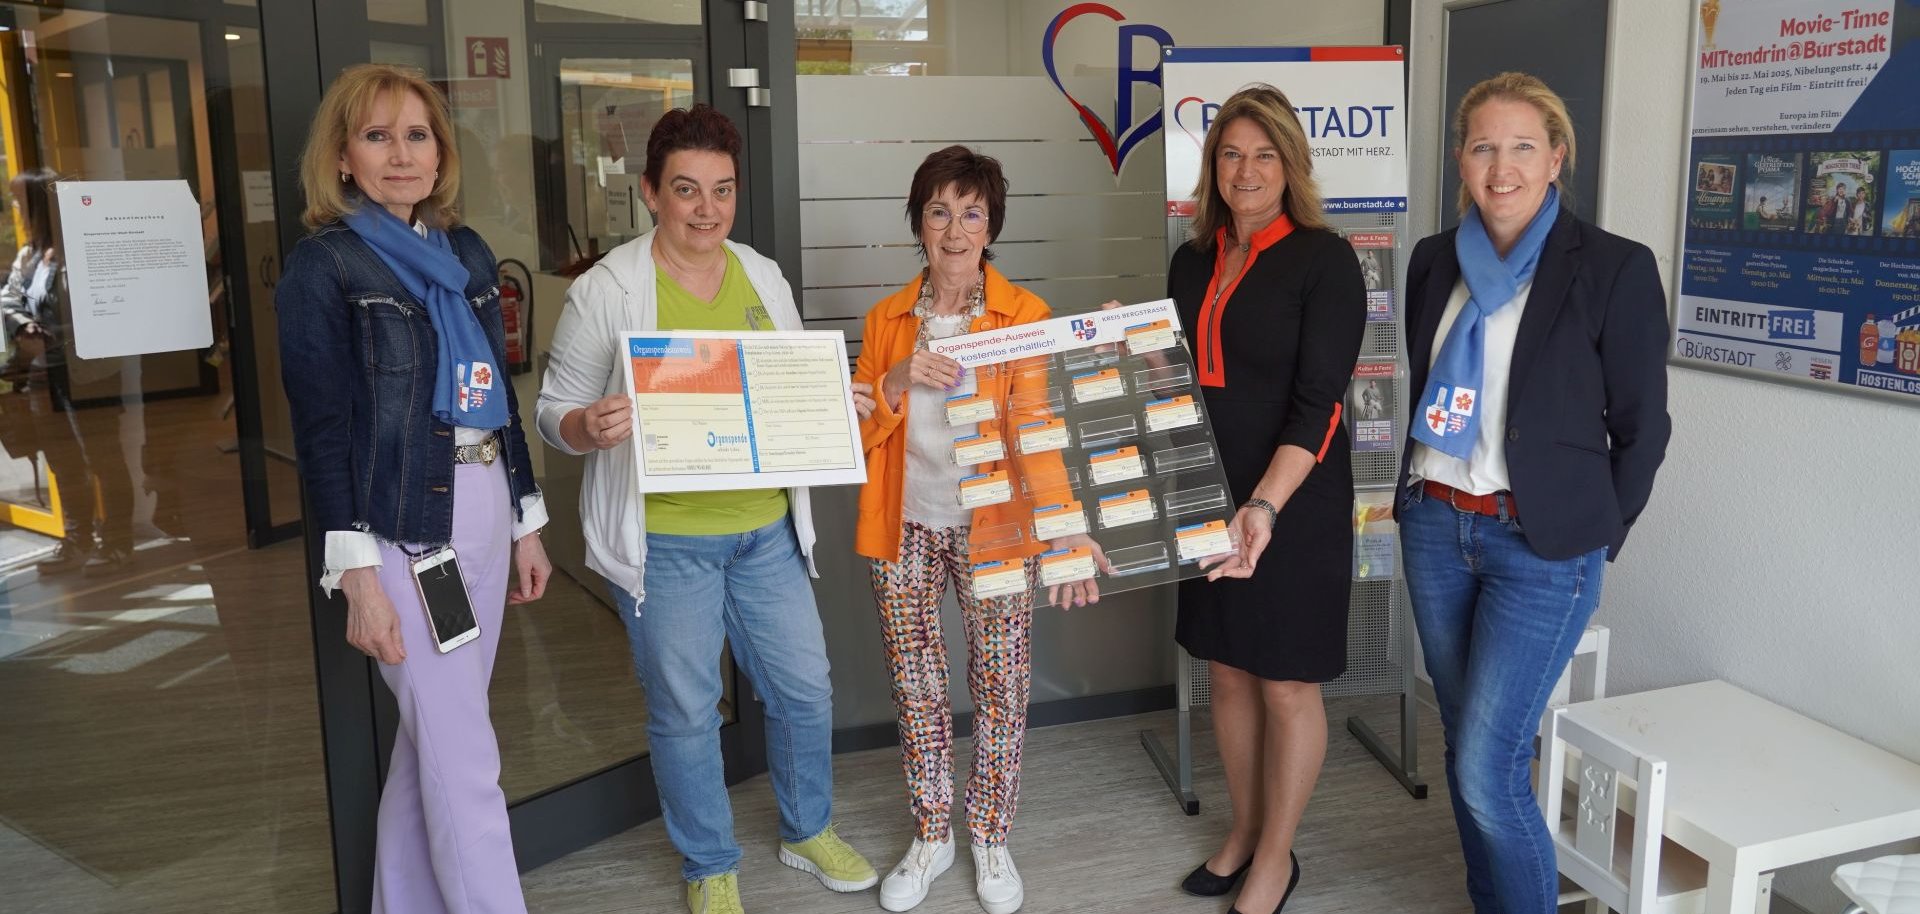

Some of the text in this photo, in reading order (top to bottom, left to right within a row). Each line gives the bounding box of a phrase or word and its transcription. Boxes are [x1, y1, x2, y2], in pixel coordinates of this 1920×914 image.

[1780, 9, 1889, 37] Movie-Time
[1711, 73, 1726, 82] Mai
[1727, 72, 1739, 81] bis
[1741, 72, 1751, 80] 22.
[1753, 69, 1769, 79] Mai
[1771, 69, 1792, 79] 2025,
[1794, 63, 1863, 77] Nibelungenstr.
[1866, 62, 1878, 71] 44
[1725, 84, 1748, 98] Jeden
[1750, 84, 1764, 95] Tag
[1765, 82, 1779, 92] ein
[1781, 82, 1801, 92] Film
[1809, 79, 1845, 90] Eintritt
[1846, 77, 1868, 88] frei!
[1779, 112, 1807, 121] Europa
[1820, 110, 1842, 118] Film:
[1752, 123, 1790, 132] verstehen,
[1791, 121, 1831, 130] verändern
[1347, 147, 1364, 157] MIT
[1366, 146, 1394, 157] HERZ.
[1322, 201, 1395, 209] www.buerstadt.de
[1101, 305, 1168, 323] KREIS BERGSTRASSE
[1695, 306, 1810, 336] EINTRITT FREI
[937, 328, 1046, 355] Organspende-Ausweis
[961, 347, 1007, 363] kostenlos
[1685, 341, 1757, 368] BÜRSTADT
